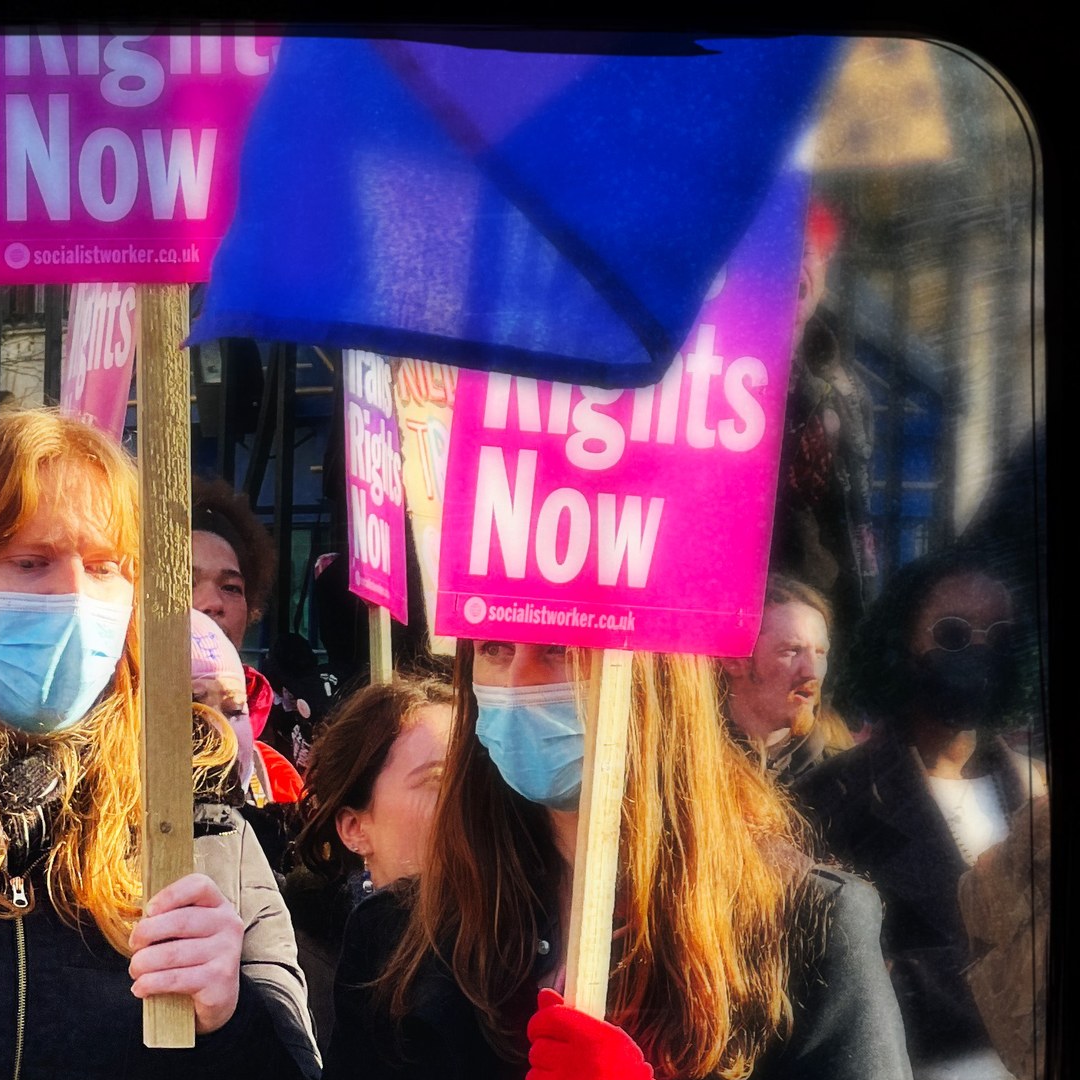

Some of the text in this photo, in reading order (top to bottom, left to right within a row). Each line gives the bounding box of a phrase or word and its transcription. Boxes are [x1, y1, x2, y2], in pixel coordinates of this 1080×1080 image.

[4, 93, 218, 222] Now
[33, 244, 201, 265] socialistworker.co.uk
[348, 401, 403, 507] Rights
[468, 445, 665, 590] Now
[488, 602, 636, 632] socialistworker.co.uk
